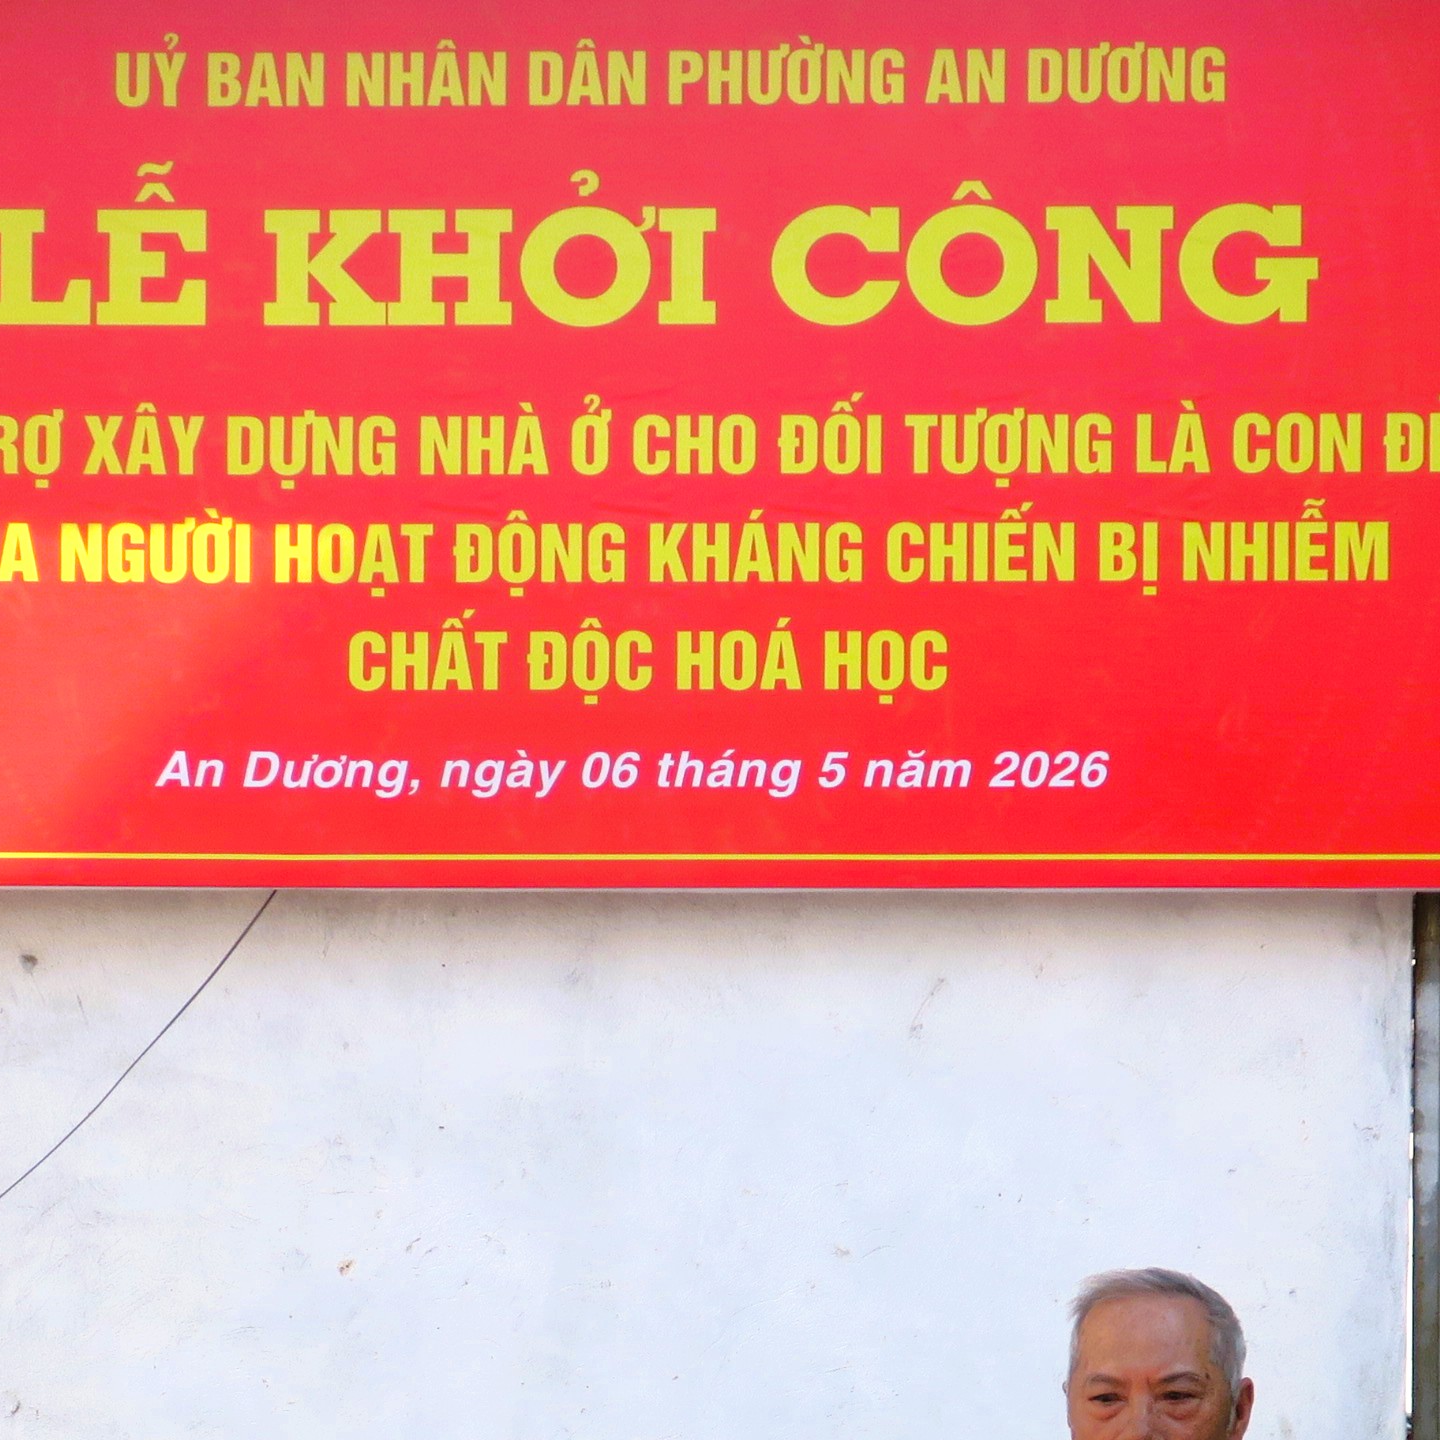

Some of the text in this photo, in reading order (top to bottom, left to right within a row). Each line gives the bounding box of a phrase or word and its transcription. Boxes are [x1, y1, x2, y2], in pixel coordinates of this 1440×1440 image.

[116, 33, 1225, 107] UỶ BAN NHÂN DÂN PHƯỜNG AN DƯƠNG
[263, 169, 717, 327] KHỞI
[771, 180, 1318, 326] CÔNG
[83, 402, 204, 475] XÂY
[227, 410, 396, 489] DỰNG
[420, 402, 549, 475] NHÀ
[571, 394, 612, 475] Ở
[633, 414, 756, 475] CHO
[778, 392, 882, 474] ĐỐI
[905, 407, 1112, 487] TƯỢNG
[1136, 400, 1210, 473] LÀ
[1233, 412, 1362, 473] CON
[58, 508, 253, 585] NGƯỜI
[274, 523, 434, 597] HOẠT
[453, 510, 625, 597] ĐỘNG
[649, 509, 862, 583] KHÁNG
[887, 502, 1075, 583] CHIẾN
[1099, 522, 1158, 595] BỊ
[1183, 500, 1389, 581] NHIỄM
[349, 609, 947, 704] CHẤT ĐỘC HOÁ HỌC
[155, 749, 1109, 798] An Dương, ngày 06 tháng 5 năm 2026
